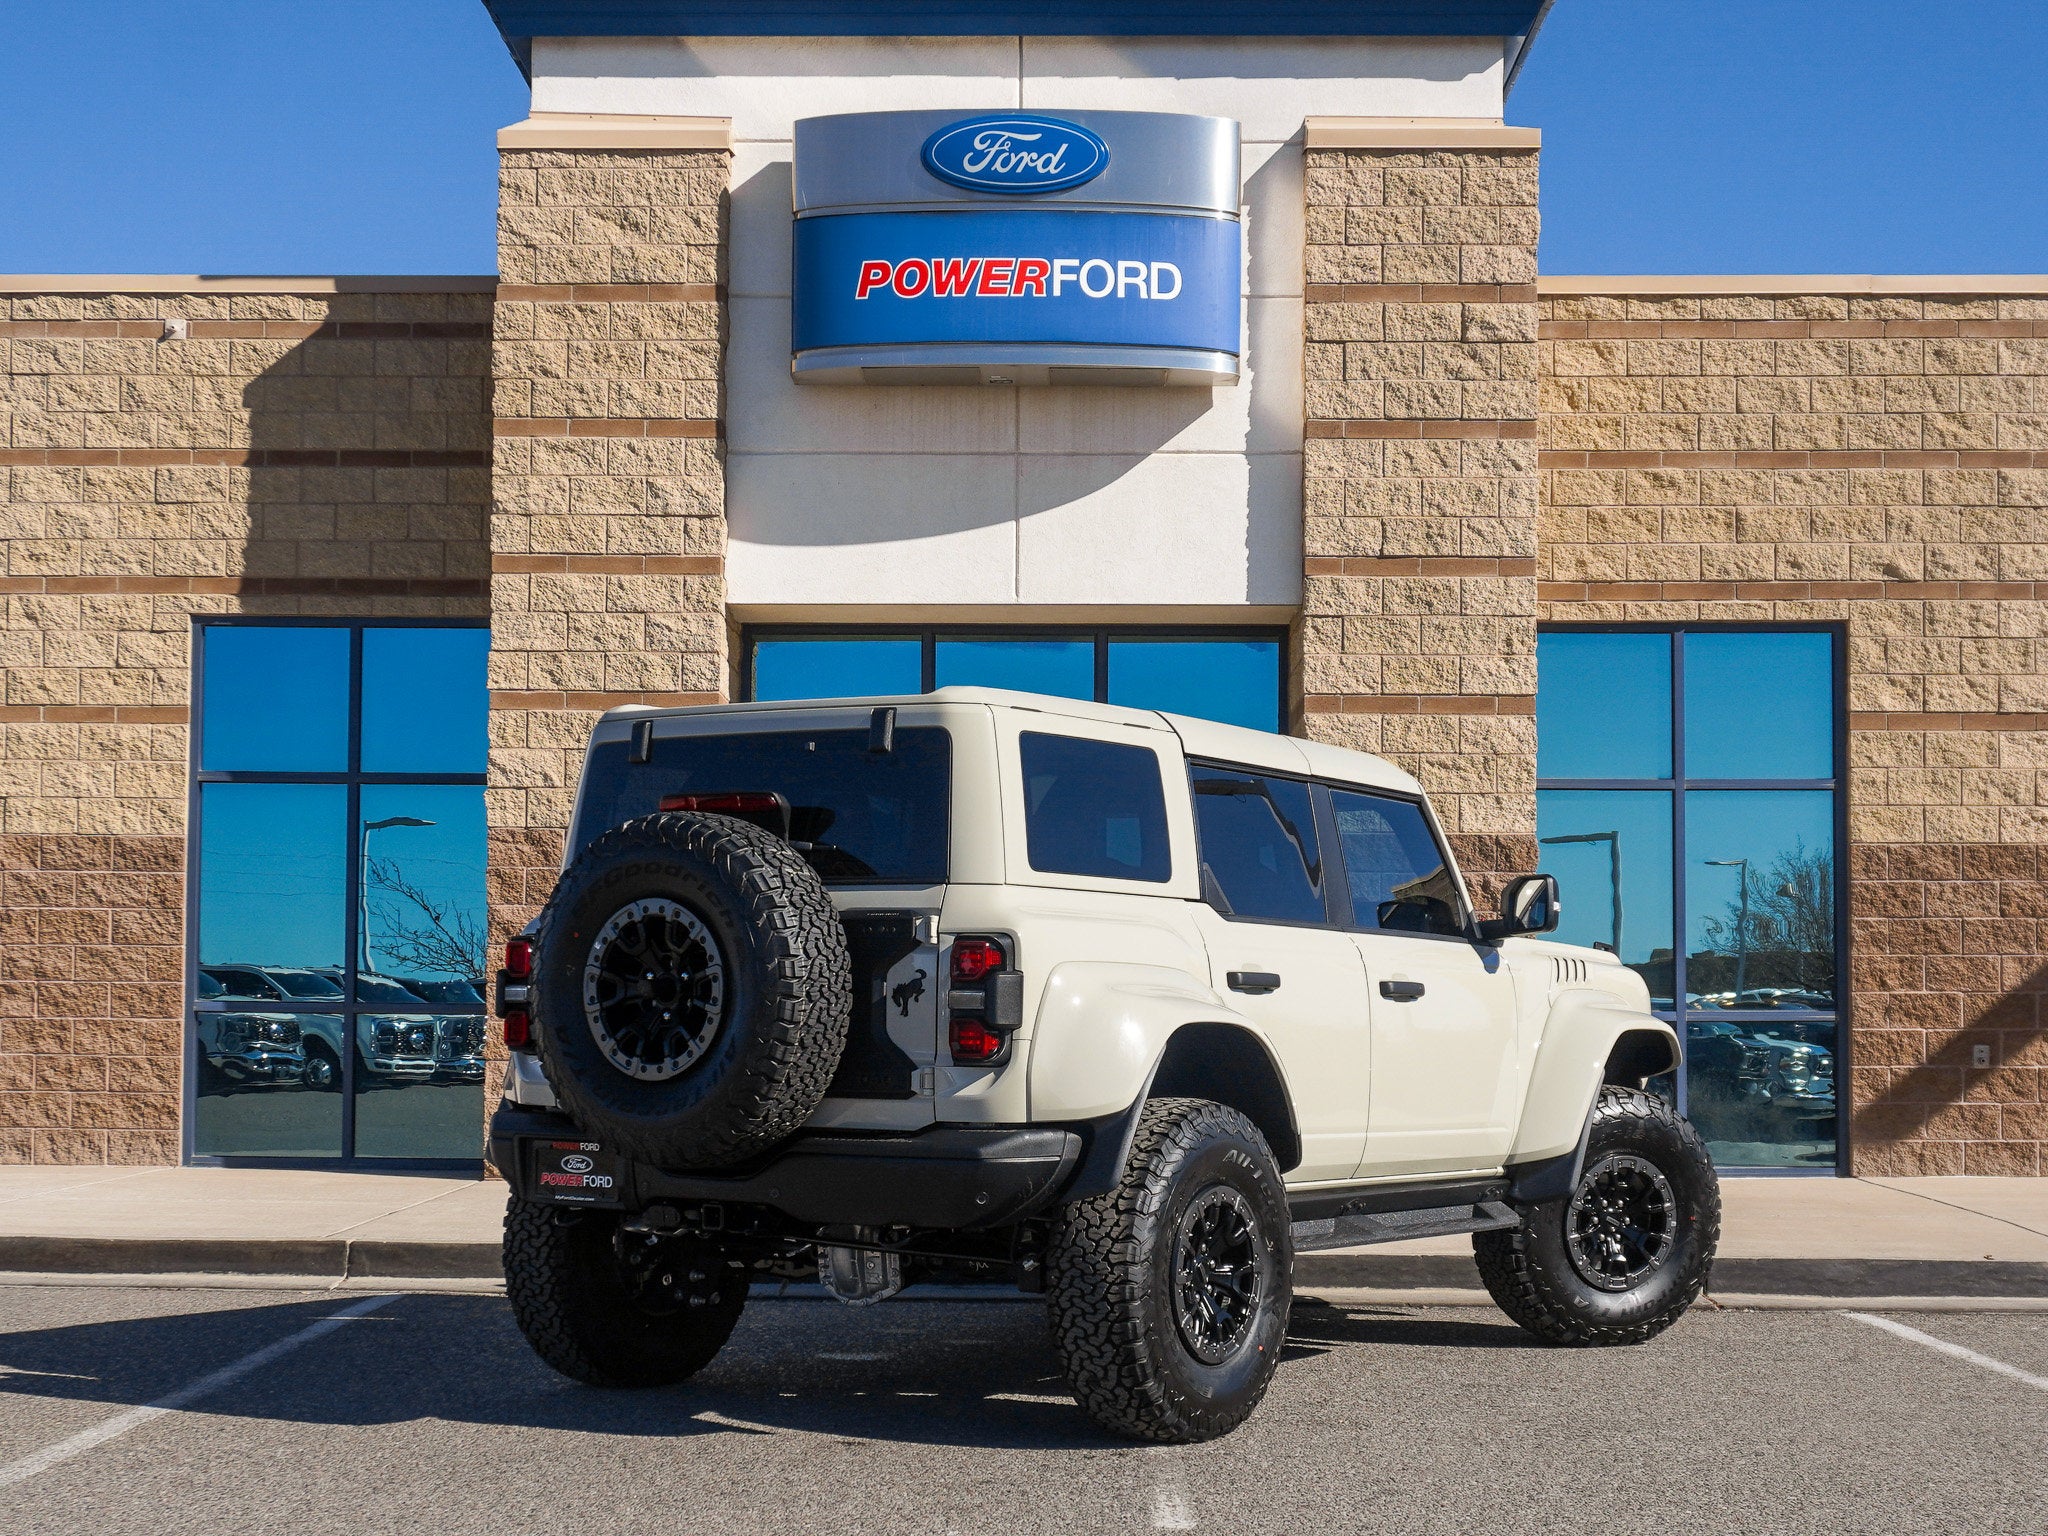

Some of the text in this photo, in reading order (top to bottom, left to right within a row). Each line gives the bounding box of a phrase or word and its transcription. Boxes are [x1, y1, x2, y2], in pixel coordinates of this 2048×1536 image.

[962, 129, 1069, 174] Ford
[855, 257, 1183, 300] POWERFORD
[567, 1157, 587, 1169] Ford
[540, 1172, 613, 1188] POWERFORD
